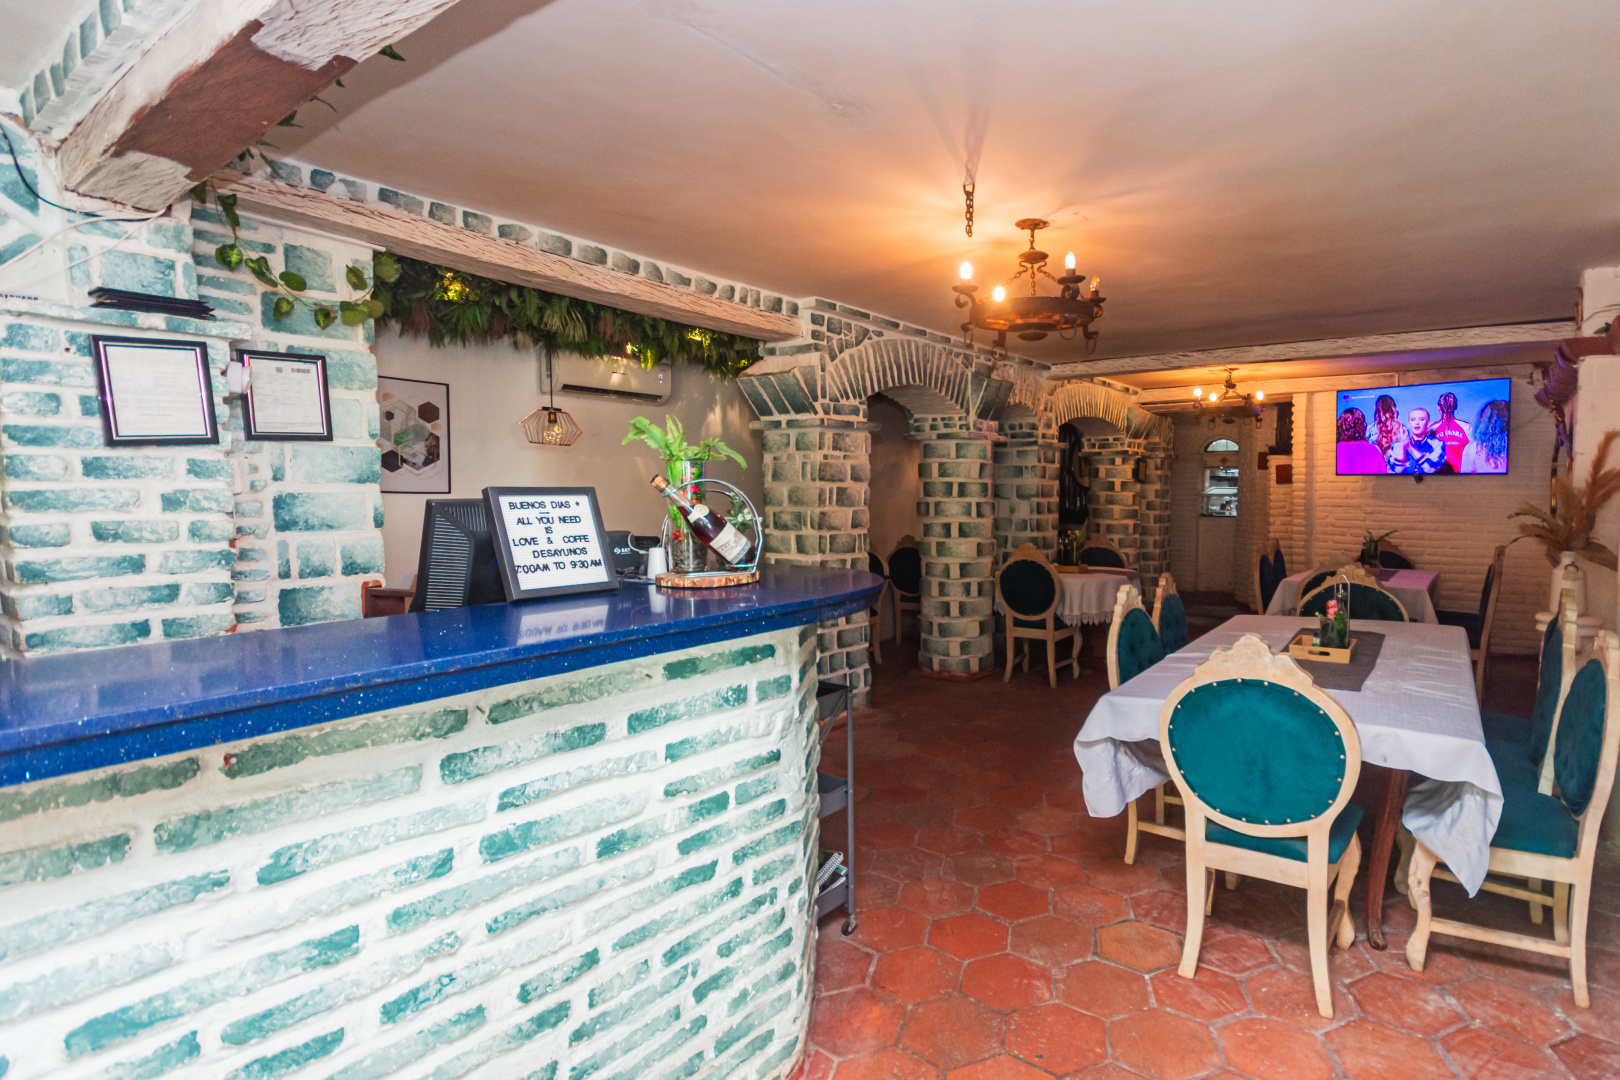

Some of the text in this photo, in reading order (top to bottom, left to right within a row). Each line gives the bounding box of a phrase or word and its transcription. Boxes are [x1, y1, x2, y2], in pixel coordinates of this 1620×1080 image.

[508, 501, 570, 510] BUENOS DIAS
[516, 516, 581, 525] ALL YOU NEED
[512, 534, 590, 546] LOVE & COFFE
[532, 547, 588, 558] DESAYUNOS
[553, 562, 566, 570] TO
[590, 558, 602, 567] AM
